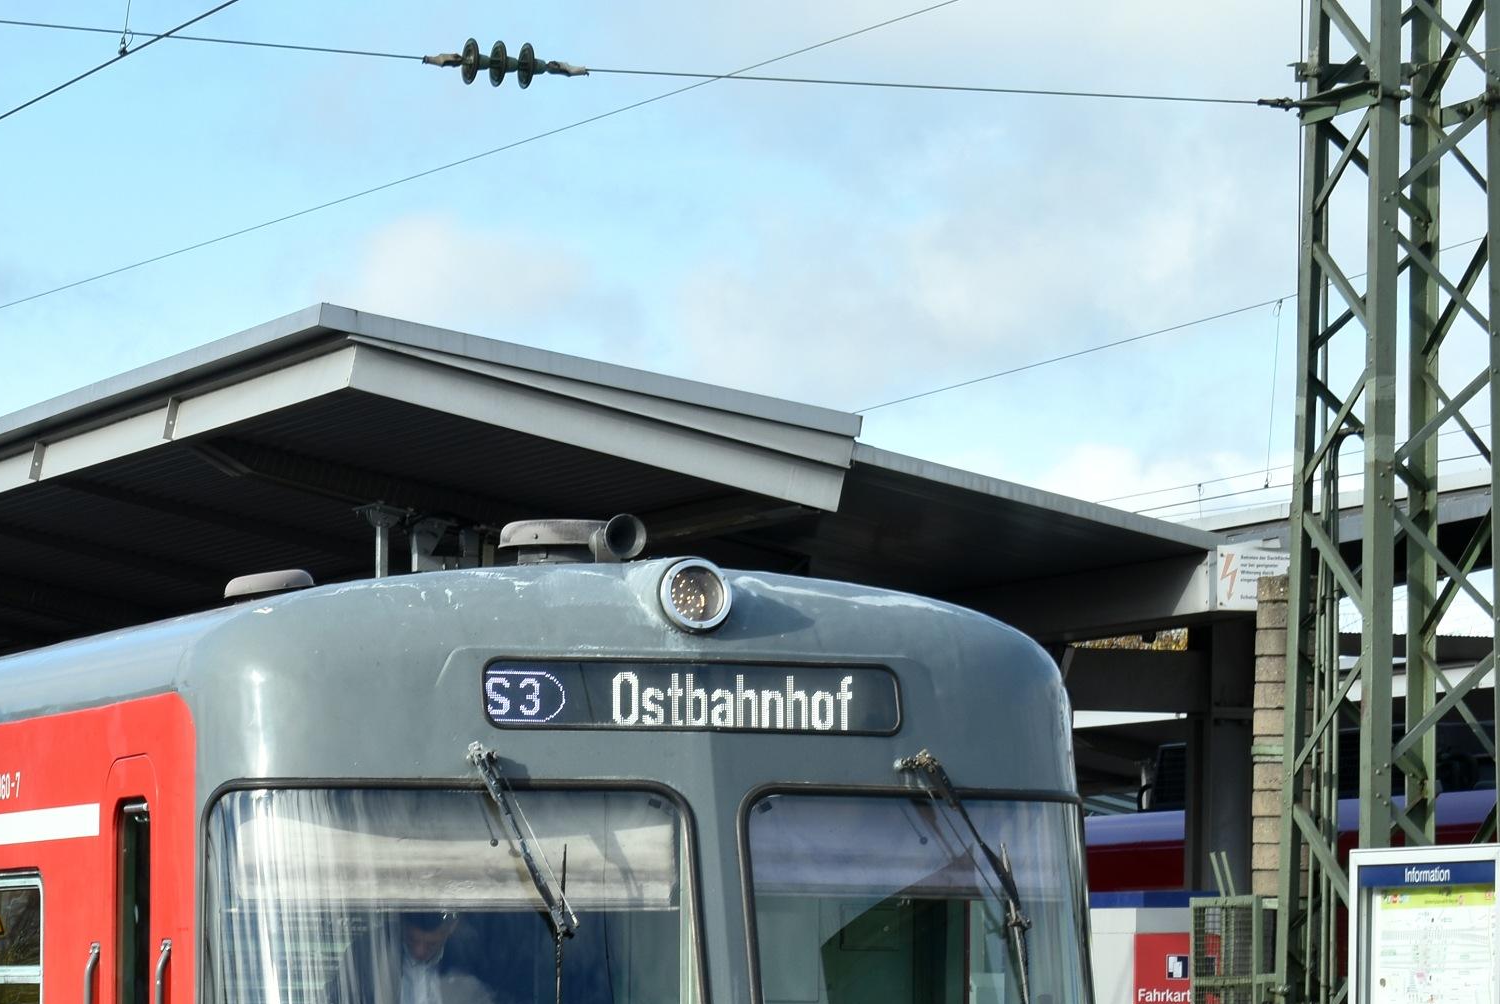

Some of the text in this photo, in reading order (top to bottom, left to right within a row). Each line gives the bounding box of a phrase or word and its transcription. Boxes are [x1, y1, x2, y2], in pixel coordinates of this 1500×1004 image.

[612, 671, 853, 731] Ostbahnhof
[1404, 865, 1451, 883] Information
[1138, 988, 1191, 1002] Fahrkart
